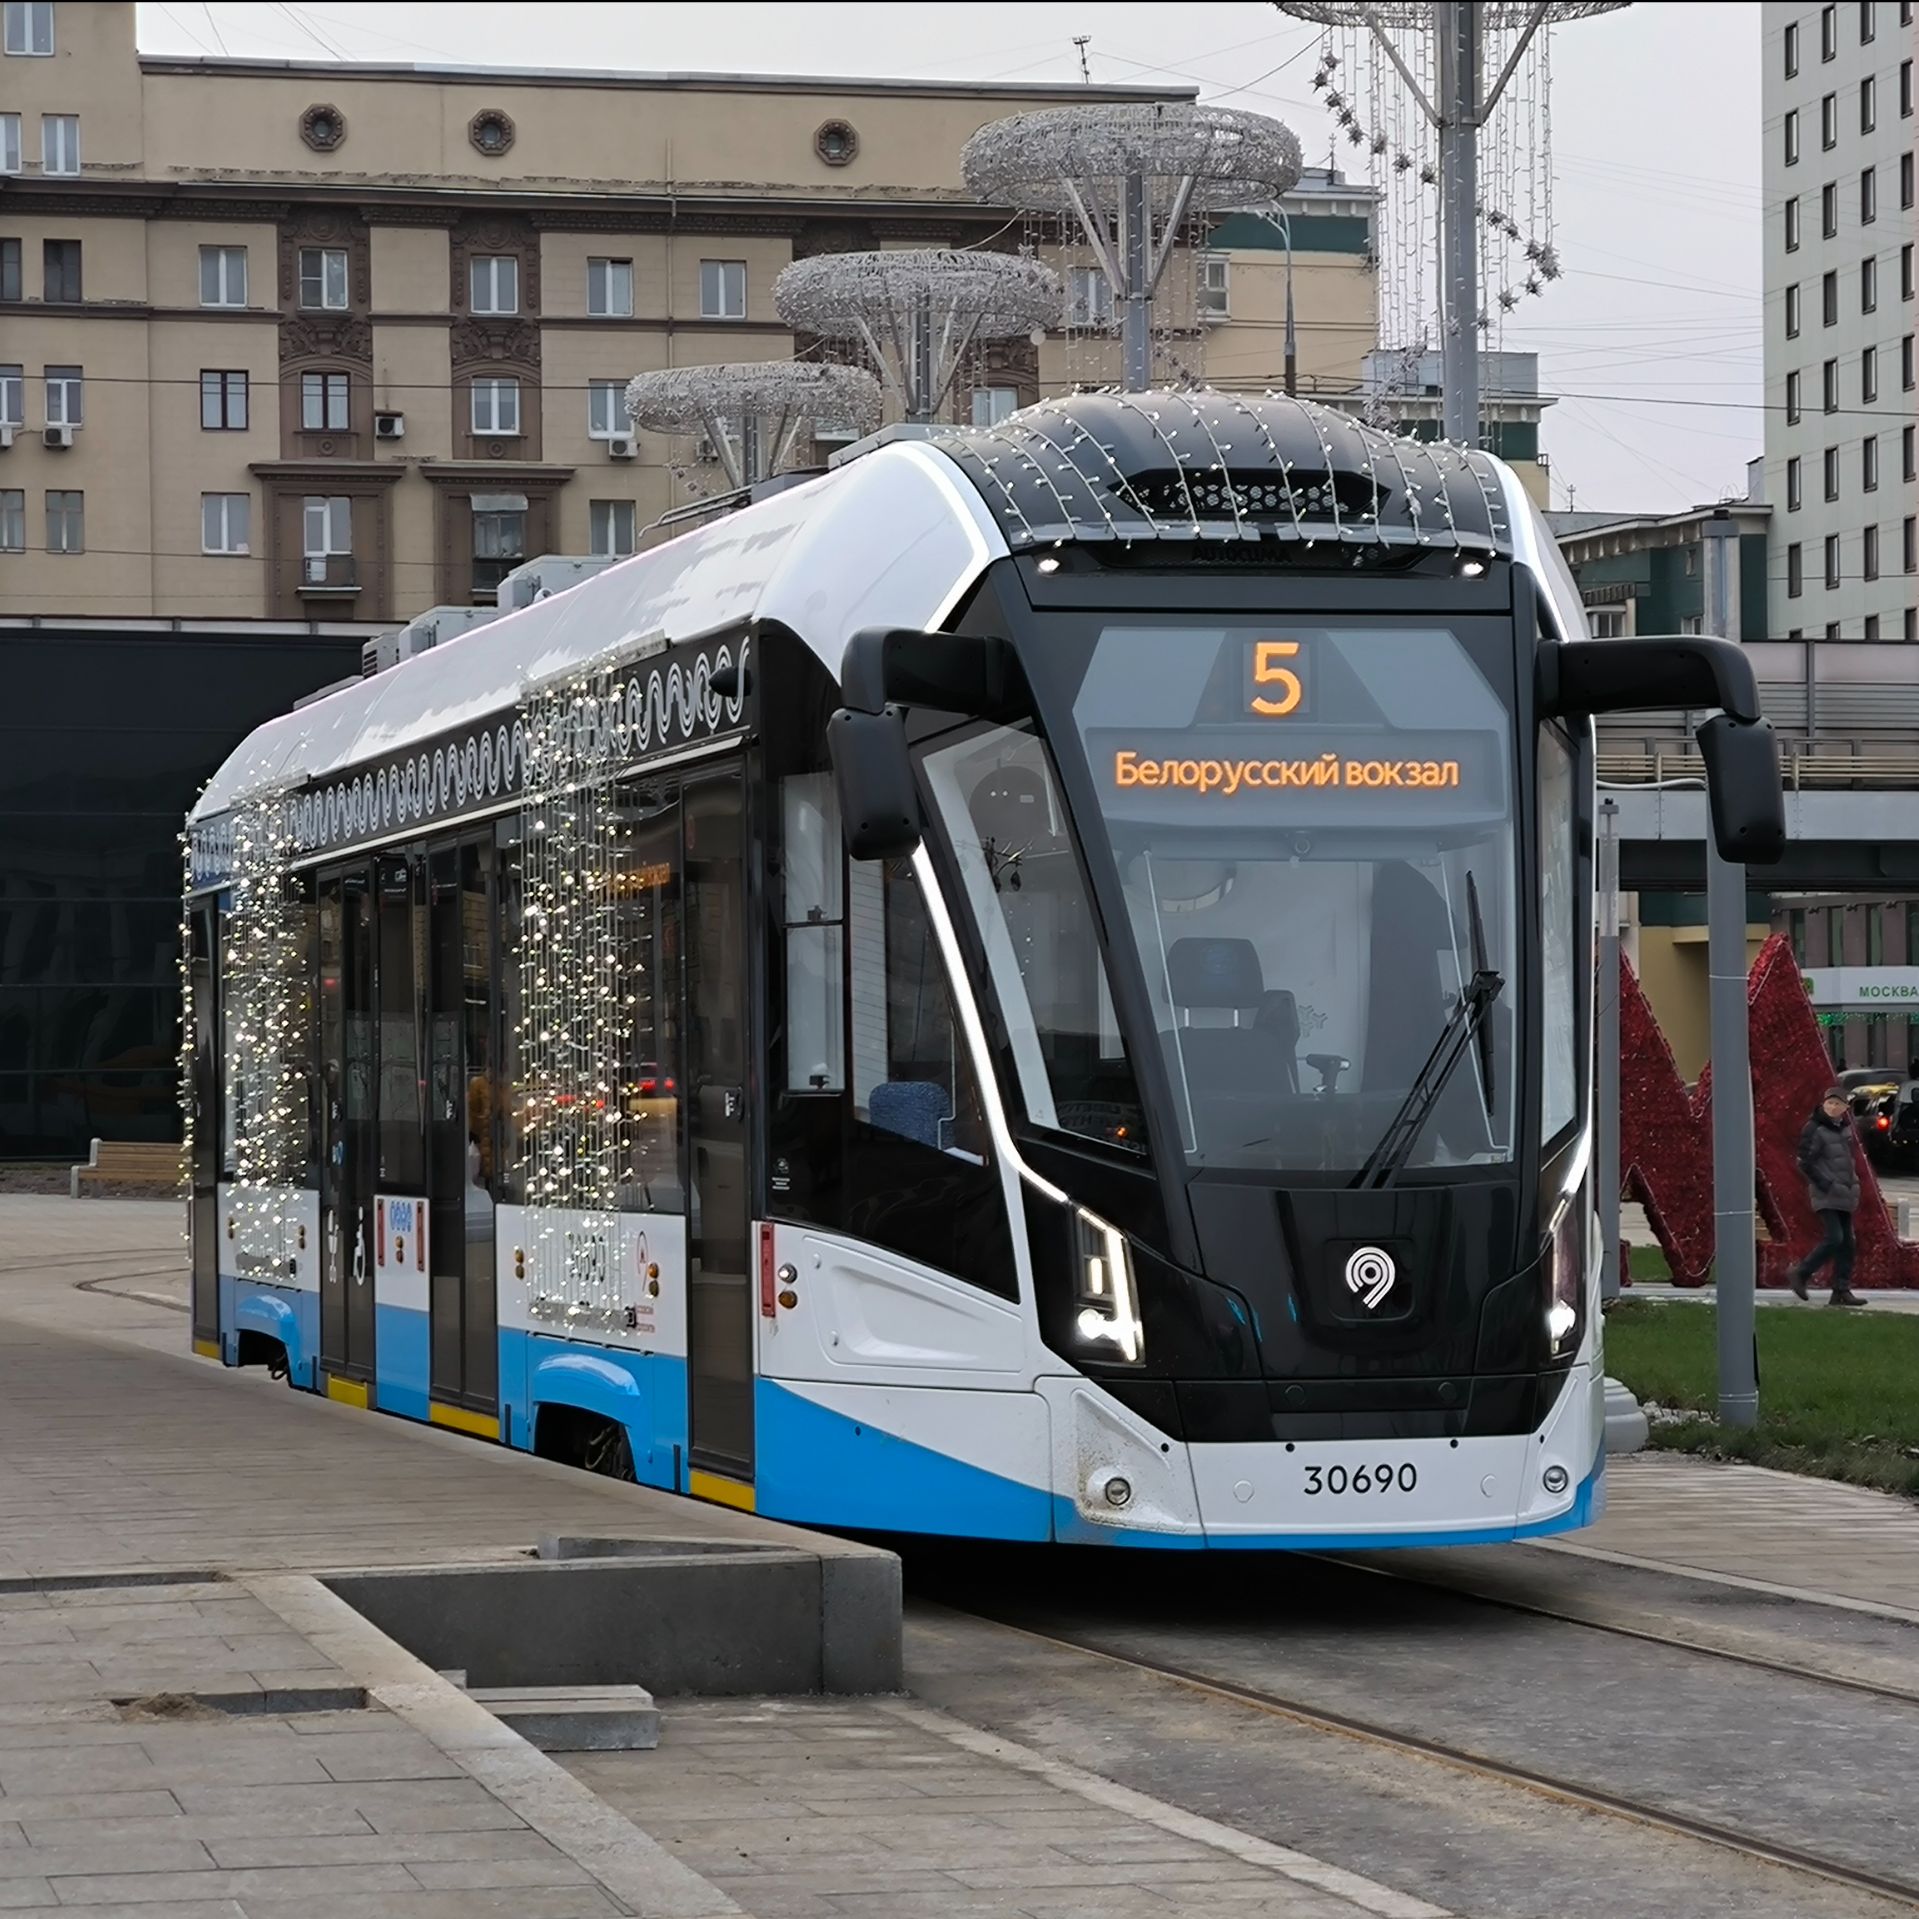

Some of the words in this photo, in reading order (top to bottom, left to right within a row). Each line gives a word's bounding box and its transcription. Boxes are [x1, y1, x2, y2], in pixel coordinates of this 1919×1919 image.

[1251, 641, 1302, 715] 5
[1114, 750, 1341, 794] Белорусский
[1345, 759, 1460, 787] вокзал
[1858, 985, 1919, 998] МОСКВА
[1303, 1462, 1418, 1495] 30690
